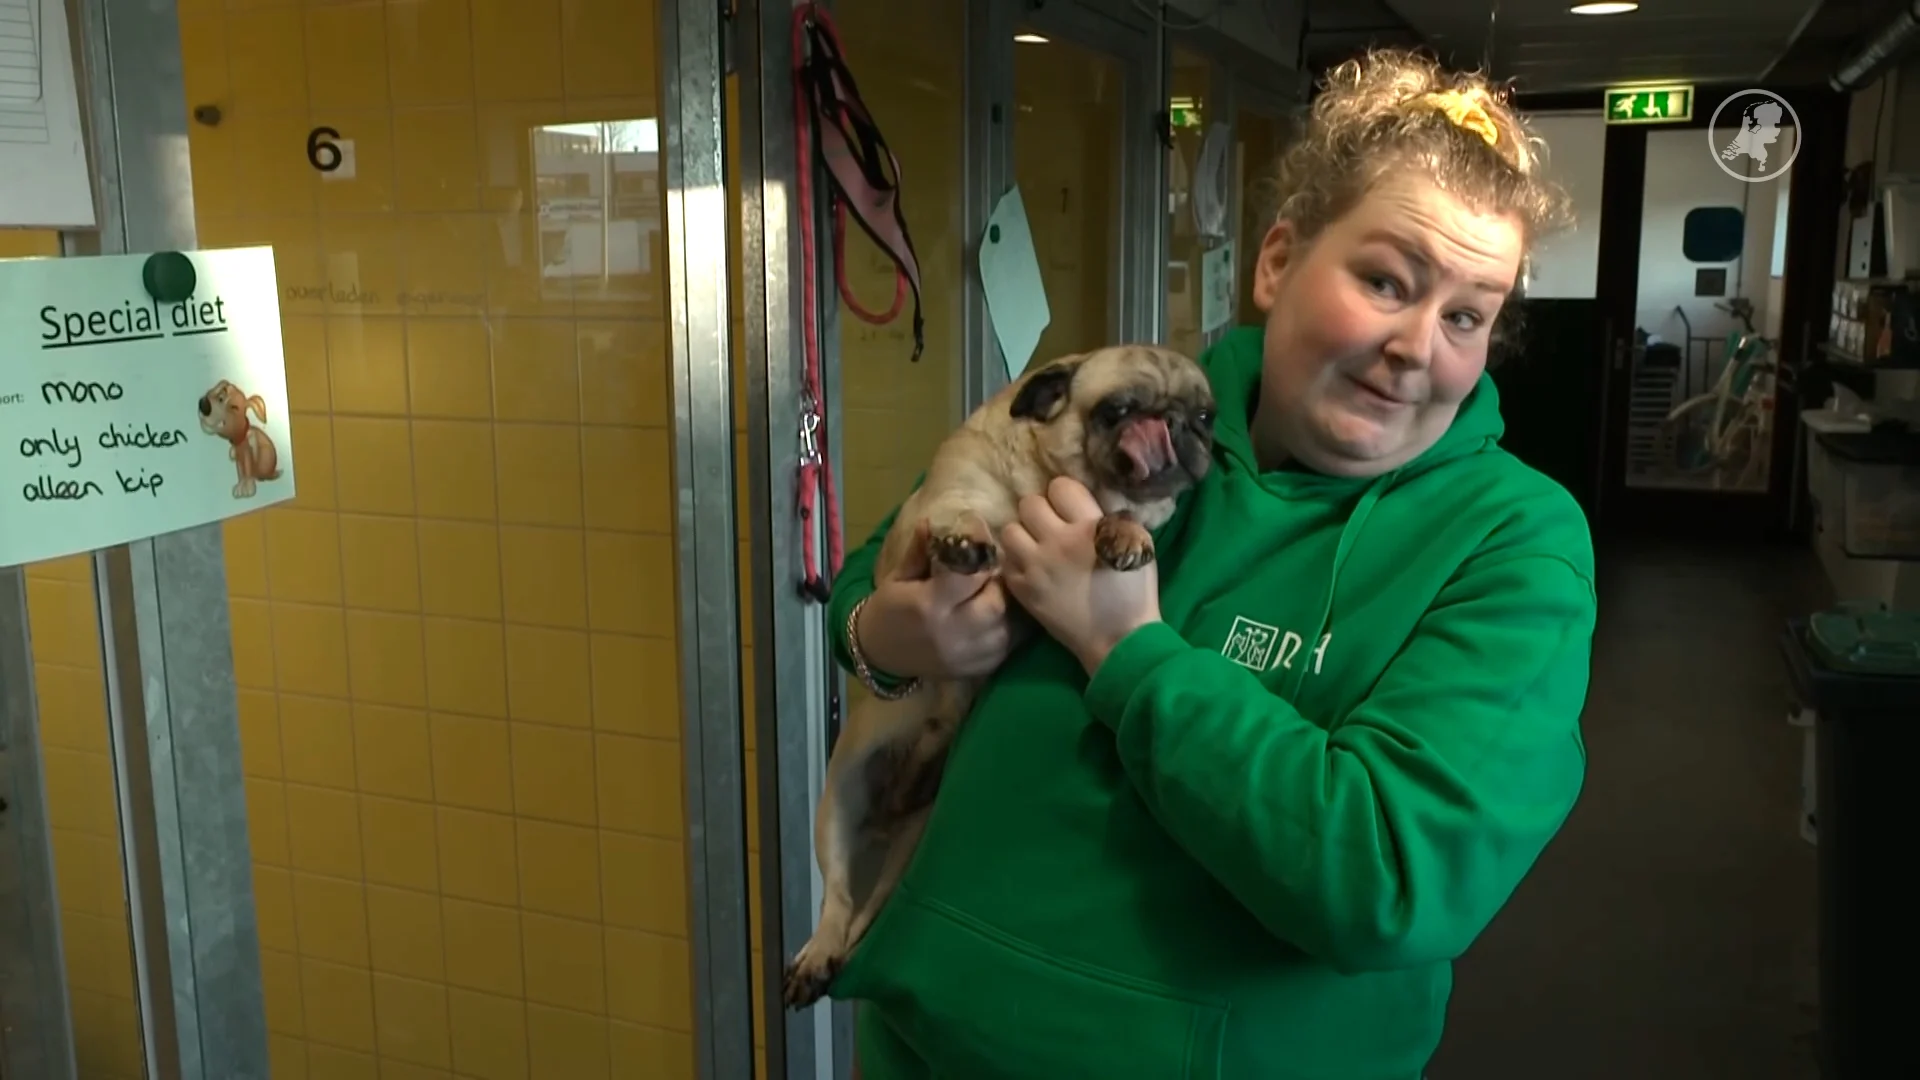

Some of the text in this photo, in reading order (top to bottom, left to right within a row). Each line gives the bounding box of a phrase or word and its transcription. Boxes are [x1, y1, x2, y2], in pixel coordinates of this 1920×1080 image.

[306, 126, 343, 173] 6
[40, 296, 227, 346] Special diet
[41, 380, 124, 405] mono
[20, 423, 188, 468] only chicken
[23, 467, 164, 502] alleen kip
